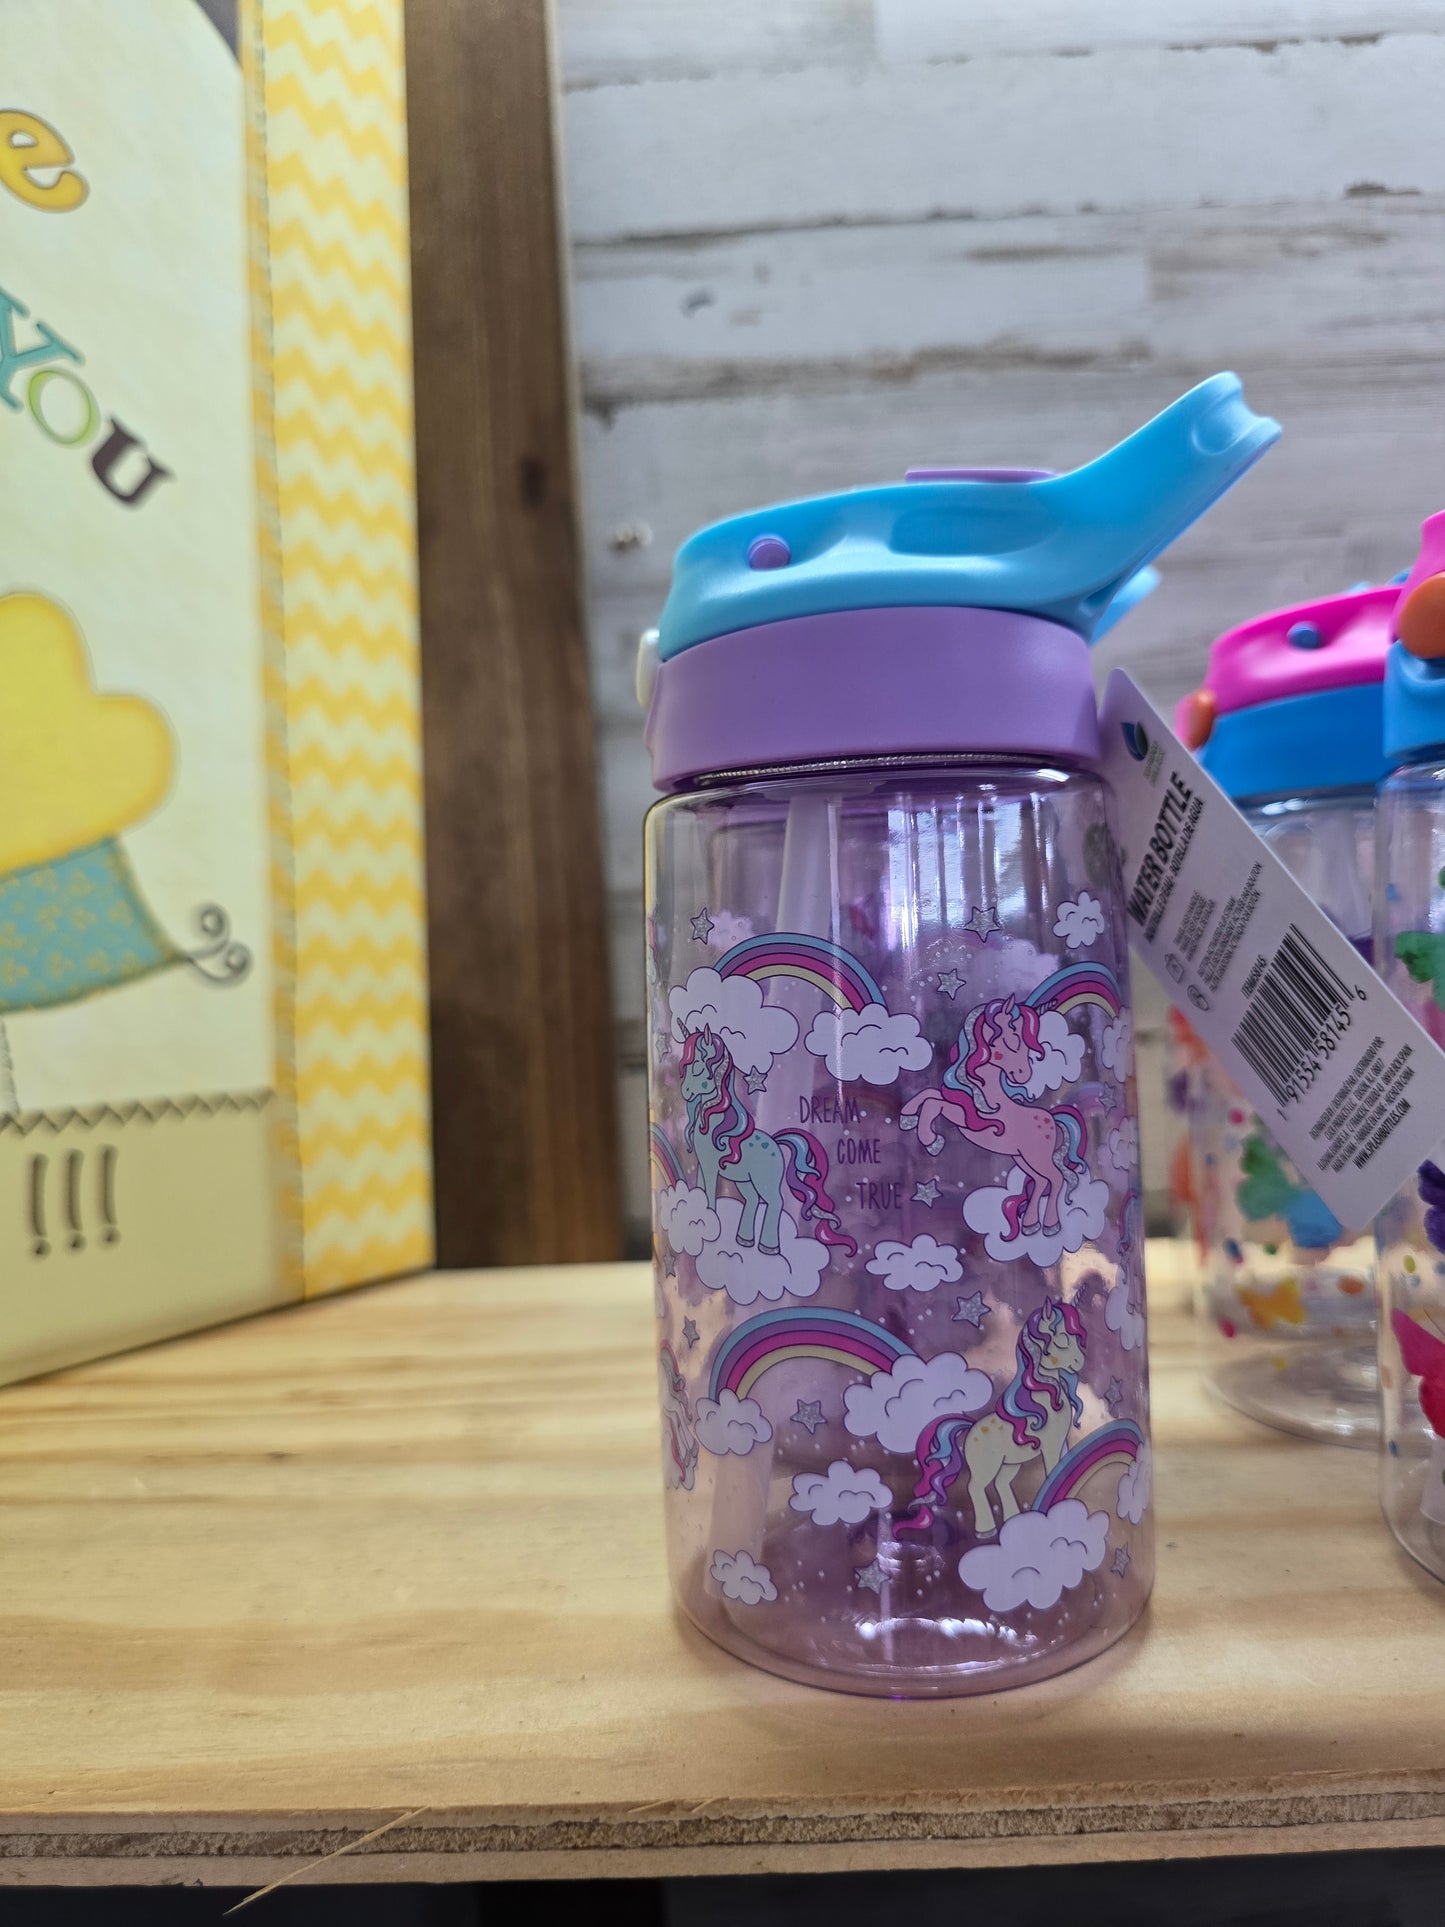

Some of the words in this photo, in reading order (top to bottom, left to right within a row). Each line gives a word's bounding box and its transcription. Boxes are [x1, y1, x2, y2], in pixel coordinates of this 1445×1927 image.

[1185, 795, 1204, 827] AGUA
[1181, 820, 1194, 839] DE
[1127, 854, 1163, 926] WATER
[1150, 771, 1192, 864] BOTTLE
[1168, 834, 1189, 873] BOTELLA
[1285, 1056, 1322, 1104] 91554
[1314, 1006, 1352, 1061] 58145
[1354, 985, 1367, 1001] 6
[800, 1096, 861, 1123] DREAM
[837, 1138, 881, 1165] COME
[856, 1182, 902, 1209] TRUE
